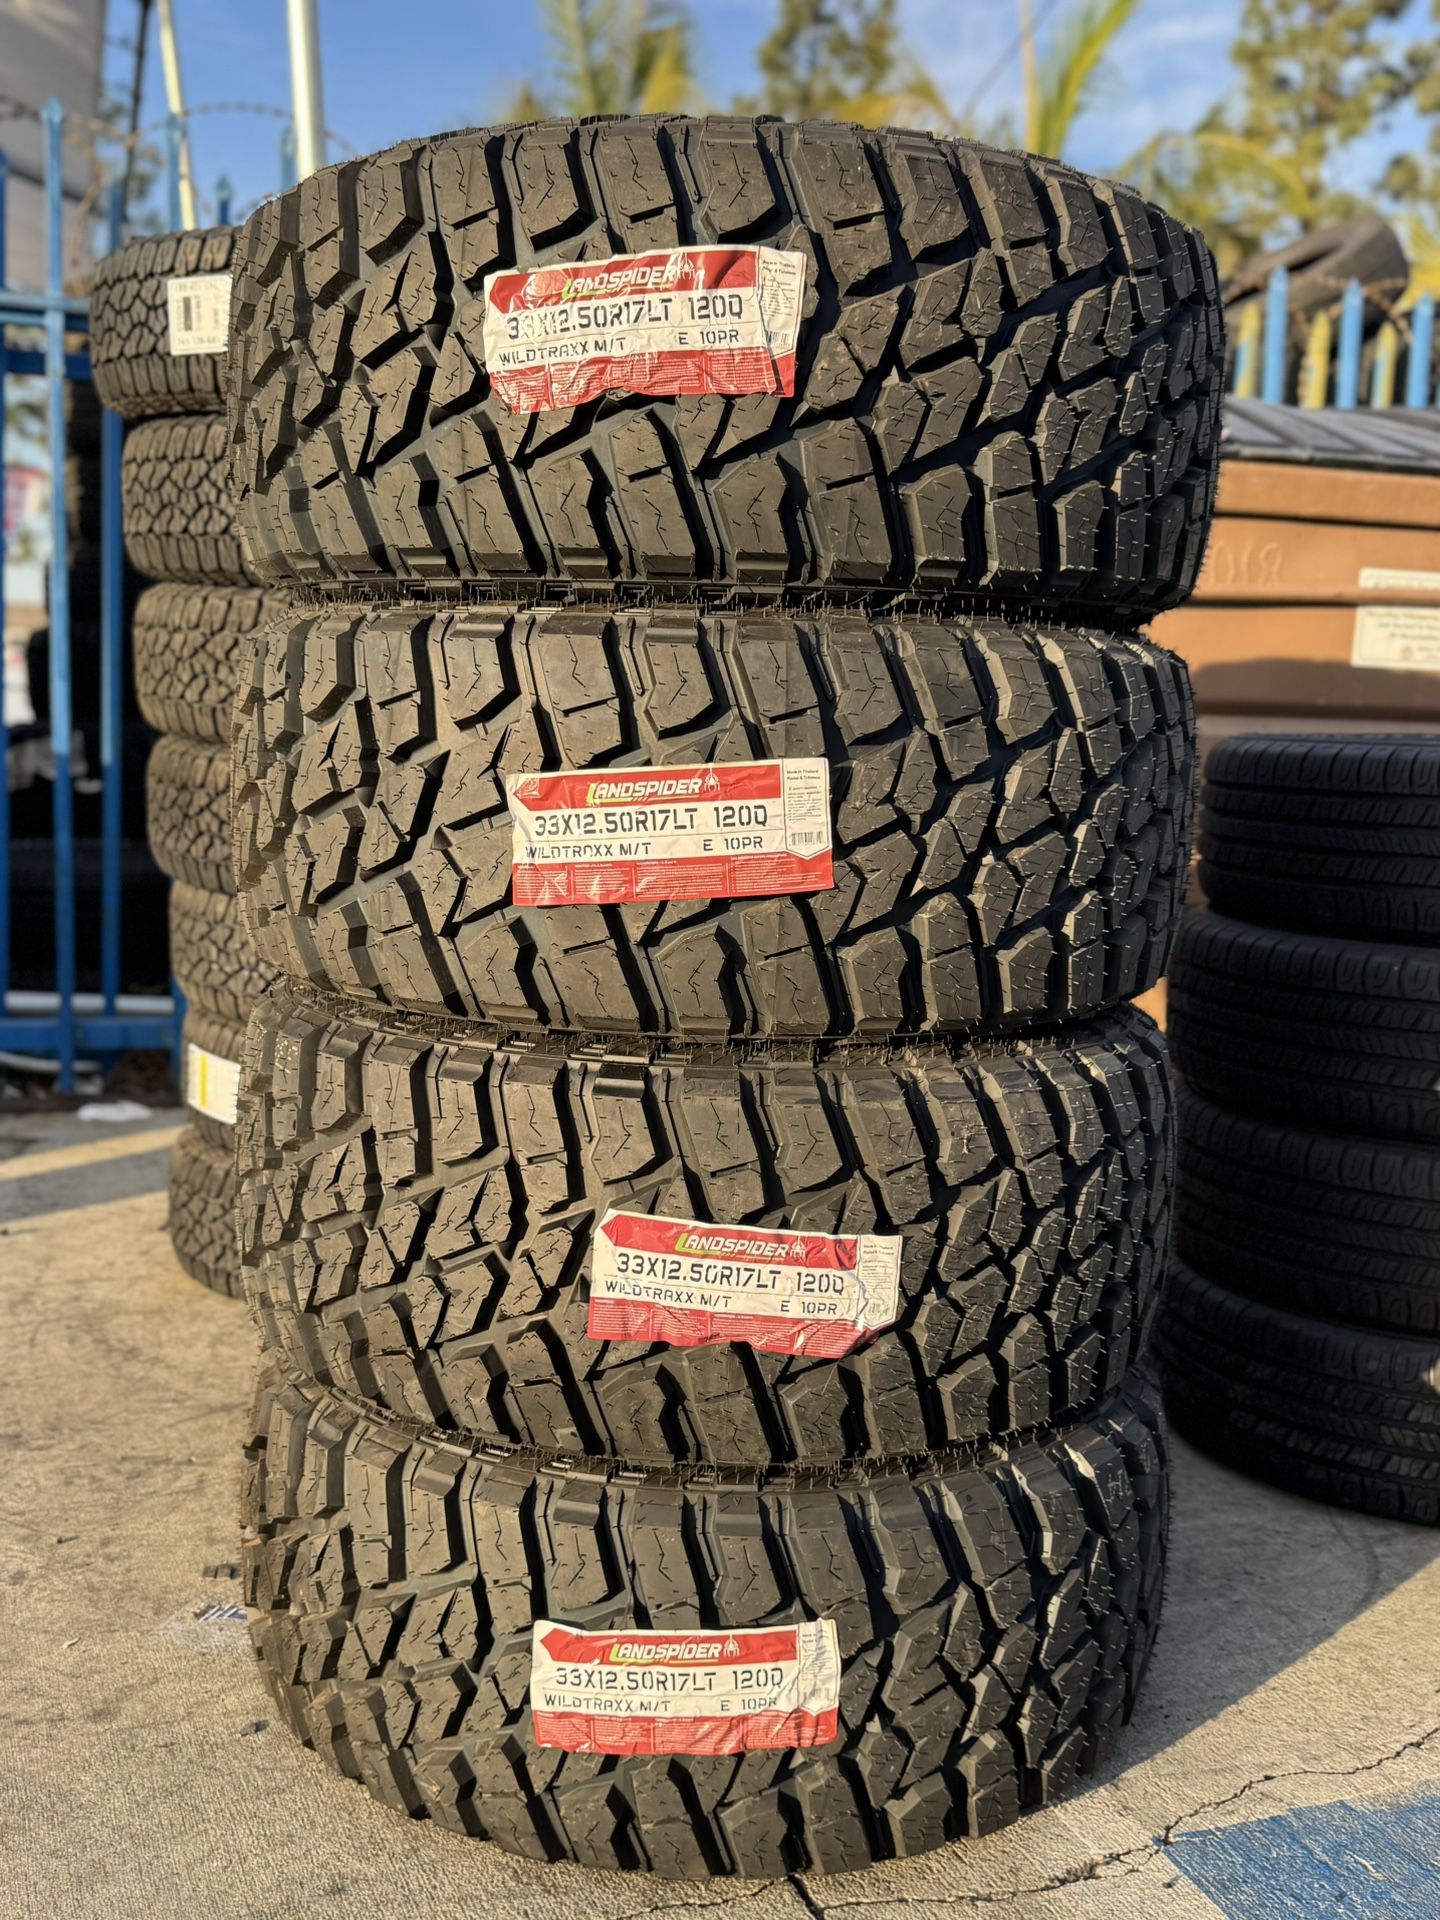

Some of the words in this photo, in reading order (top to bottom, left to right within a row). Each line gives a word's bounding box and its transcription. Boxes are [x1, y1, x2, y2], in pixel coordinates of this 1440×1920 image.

[561, 264, 678, 299] LANDSPIDER
[688, 294, 743, 321] 120Q
[499, 340, 589, 366] WILDTRAXX
[594, 337, 627, 354] M/T
[678, 332, 689, 345] E
[699, 329, 740, 346] 10PR
[585, 778, 703, 805] LANDSPIDER
[534, 807, 698, 837] 33X12.50R17LT
[713, 804, 768, 829] 120Q
[619, 842, 652, 857] M/T
[703, 839, 714, 852] E
[724, 836, 764, 851] 10PR
[675, 1232, 789, 1259] LANDSPIDER
[616, 1252, 782, 1290] 33X12.50R17LT
[796, 1271, 845, 1296] 120Q
[605, 1280, 694, 1304] WILDTRAXX
[699, 1293, 733, 1309] M/T
[780, 1300, 791, 1313] E
[801, 1301, 838, 1315] 10PR
[608, 1642, 724, 1665] LANDSPIDER
[555, 1666, 717, 1692] 33X12.50R17LT
[732, 1667, 784, 1690] 120Q
[544, 1693, 634, 1712] WILDTRAXX
[639, 1700, 672, 1712] M/T
[720, 1699, 731, 1712] E
[742, 1697, 778, 1711] 10PR
